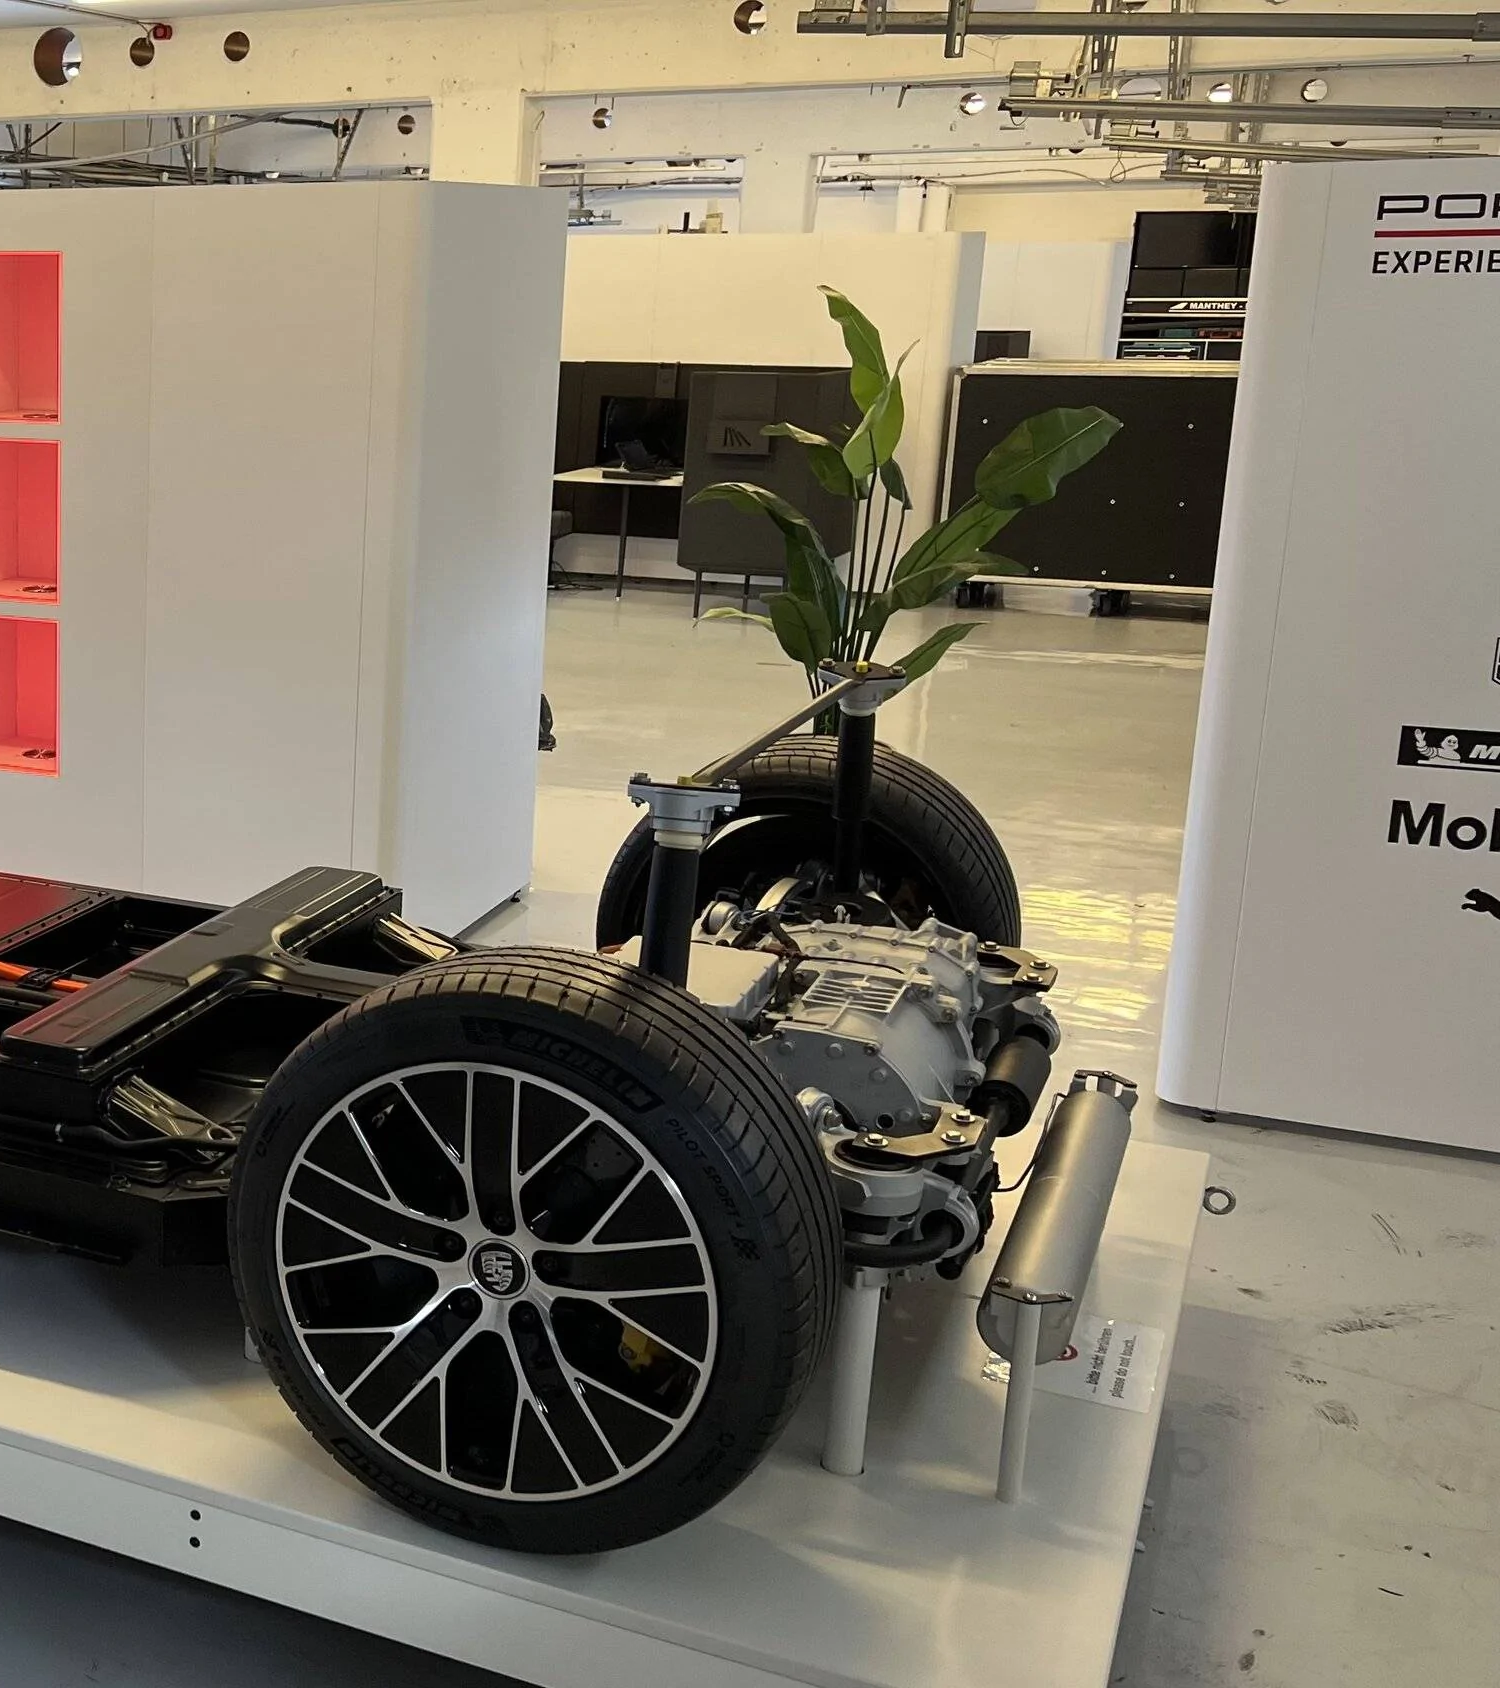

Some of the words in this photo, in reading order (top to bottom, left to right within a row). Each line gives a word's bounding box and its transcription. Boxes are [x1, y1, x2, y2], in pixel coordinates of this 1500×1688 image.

[1372, 250, 1500, 273] EXPERIE
[507, 1028, 655, 1111] MICHELIN
[666, 1119, 707, 1160] PILOT
[702, 1165, 740, 1218] SPORT
